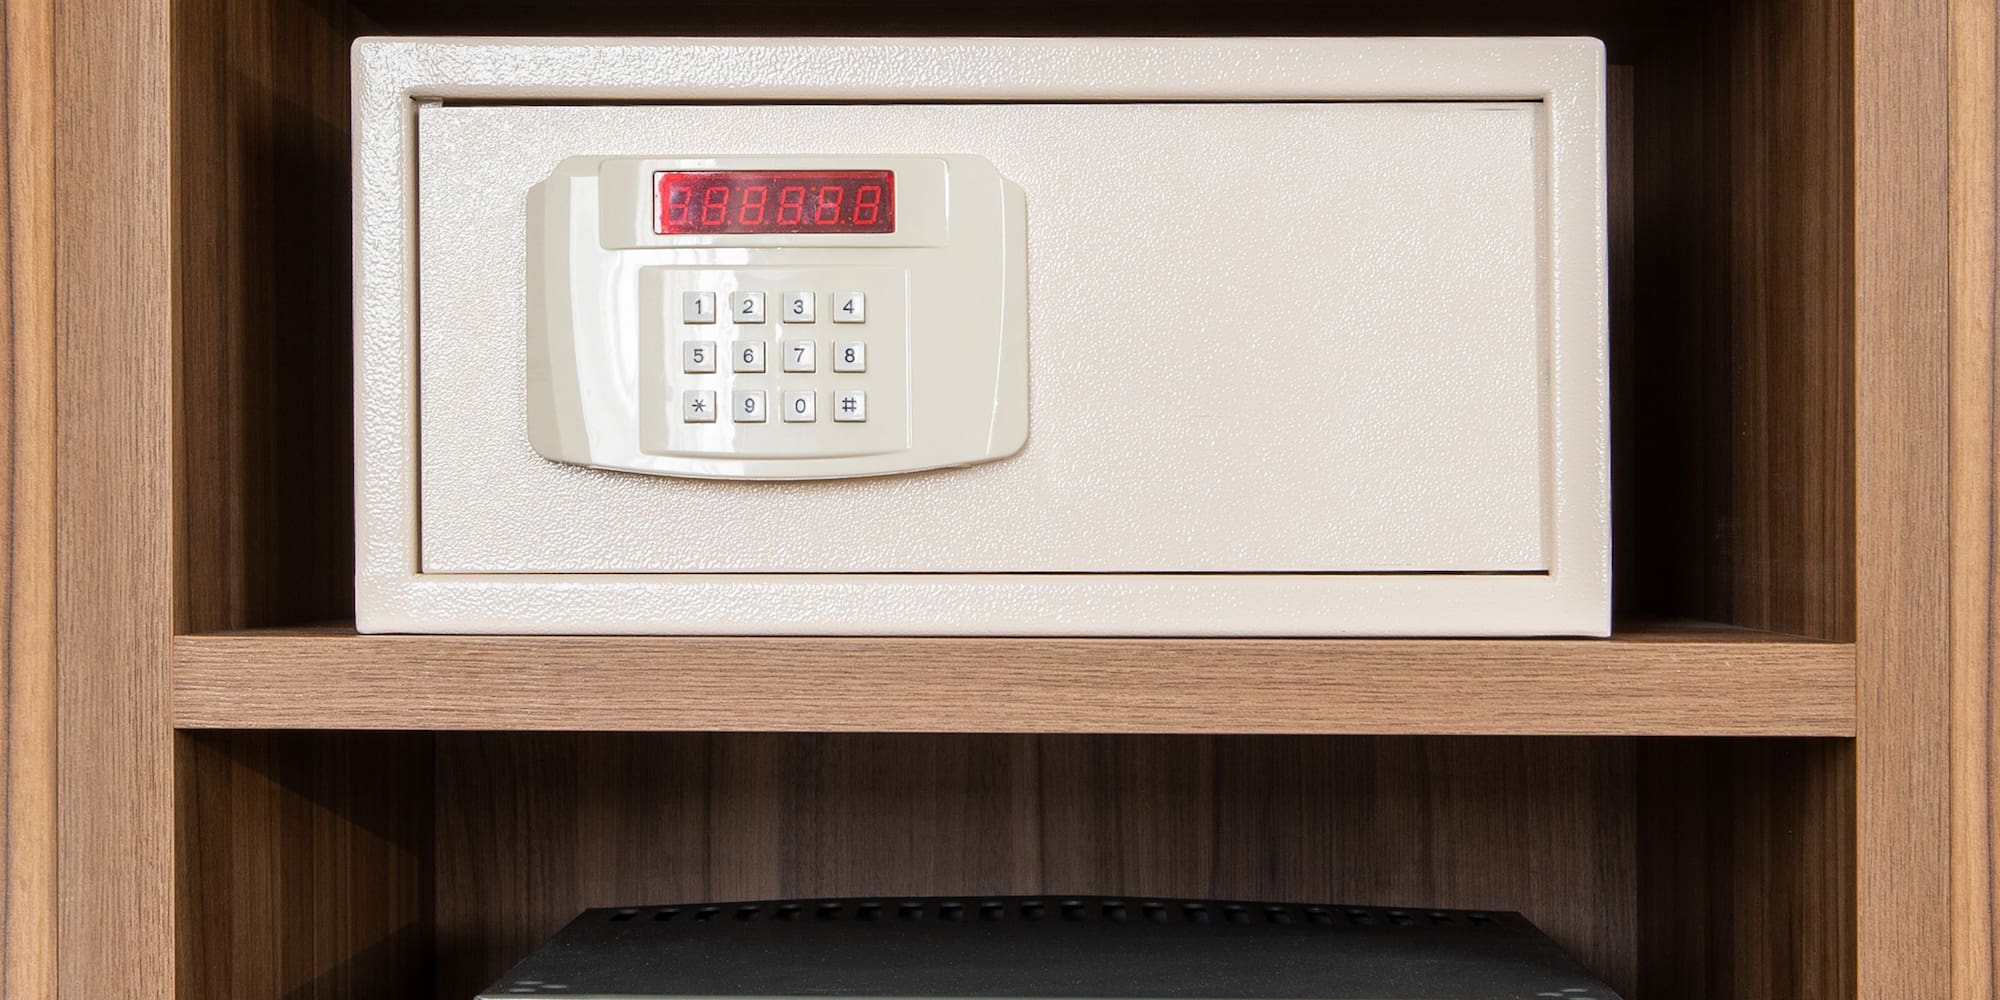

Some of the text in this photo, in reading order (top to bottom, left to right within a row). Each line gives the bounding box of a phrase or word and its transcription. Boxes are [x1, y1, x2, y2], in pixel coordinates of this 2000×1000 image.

[694, 299, 854, 315] 1 2 3 4
[693, 347, 856, 364] 5 6 7 8
[744, 397, 755, 414] 9
[795, 398, 806, 414] 0
[841, 397, 857, 413] #
